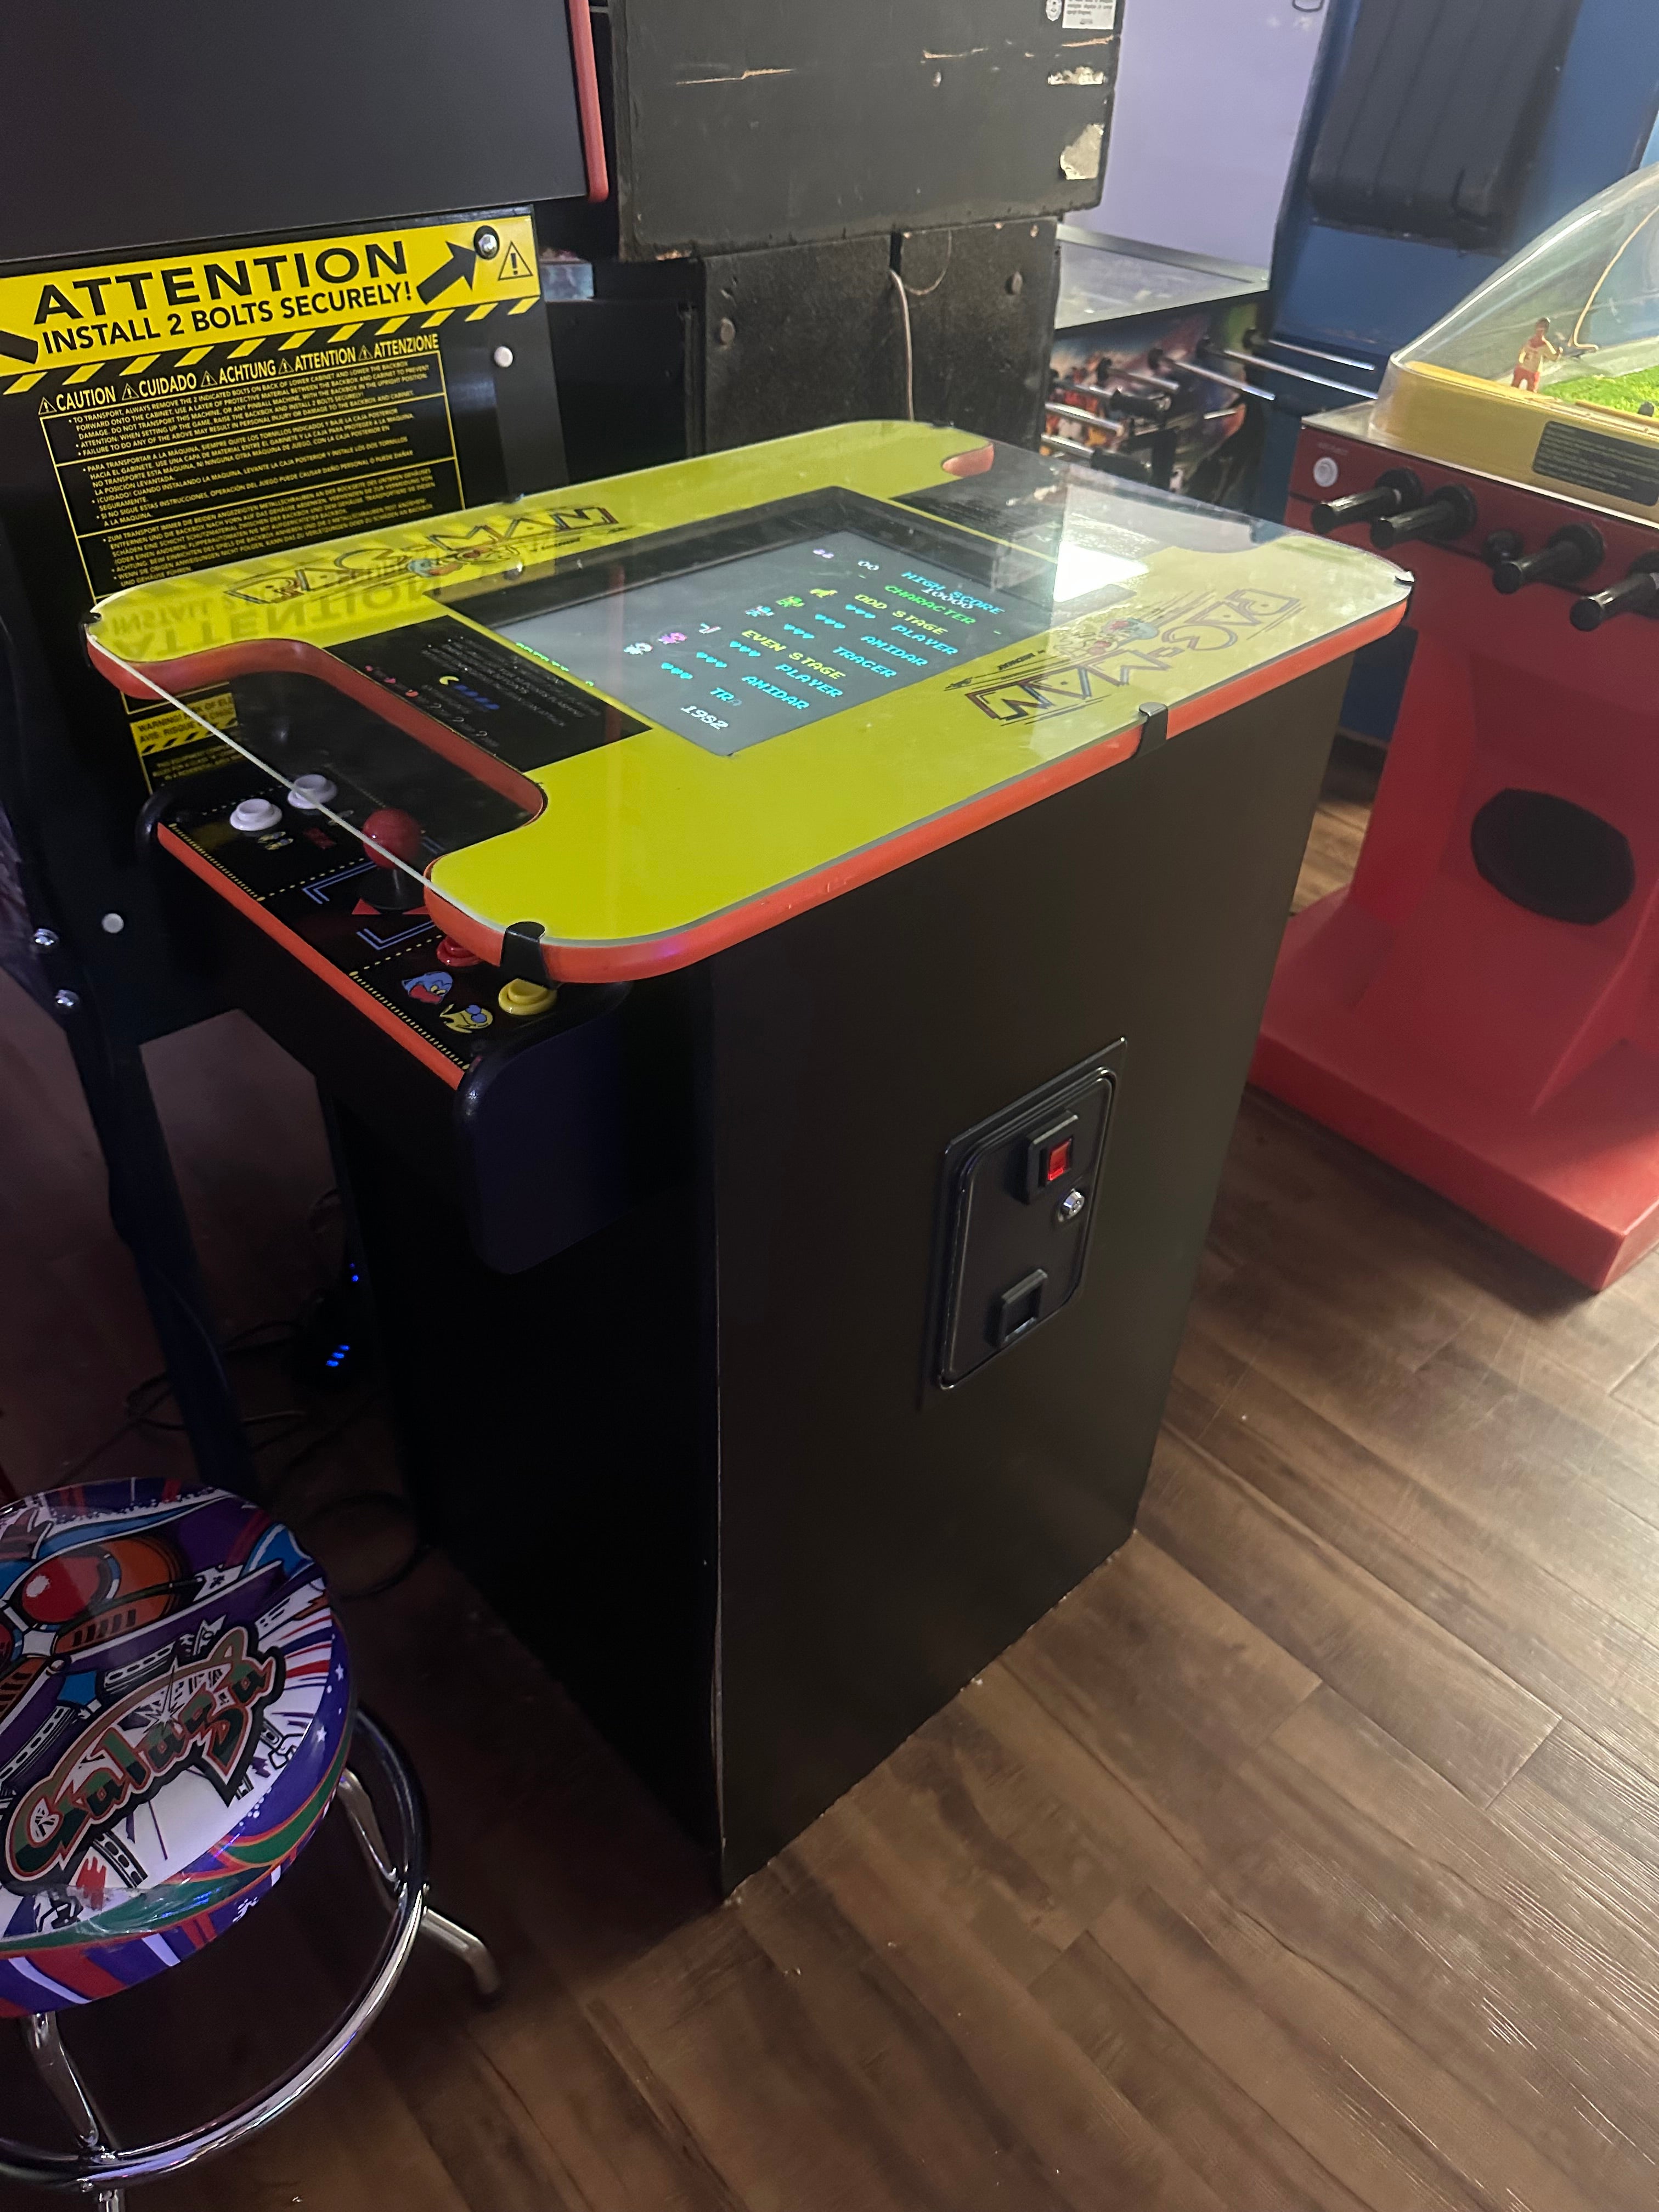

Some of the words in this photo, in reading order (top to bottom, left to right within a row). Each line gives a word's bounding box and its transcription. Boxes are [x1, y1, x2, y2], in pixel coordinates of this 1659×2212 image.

[34, 241, 408, 325] ATTENTION
[42, 319, 161, 355] INSTALL
[167, 313, 182, 336] 2
[194, 300, 273, 331] BOLTS
[282, 281, 412, 318] SECURELY!
[53, 385, 117, 412] CAUTION
[137, 372, 198, 398] CUIDADO
[216, 359, 277, 385] ACHTUNG
[292, 346, 357, 372] ATTENTION
[372, 332, 439, 359] ATTENZIONE
[125, 405, 151, 414] ALWAYS
[151, 400, 179, 409] REMOVE
[138, 417, 175, 428] TRANSPORT
[75, 420, 110, 431] FORWARD
[110, 416, 131, 425] ONTO
[119, 432, 141, 440] WHEN
[141, 427, 168, 436] SETTING
[82, 446, 109, 455] FAILURE
[171, 431, 193, 439] ABOVE
[884, 585, 976, 624] CHARACTER
[901, 571, 946, 591] HIGH
[950, 590, 1005, 614] SCORE
[922, 588, 973, 610] 10000
[855, 594, 887, 610] ODD
[893, 611, 948, 635] STAGE
[742, 630, 787, 652] EVEN
[789, 652, 845, 679] STAGE
[861, 636, 928, 666] AMIDAR
[891, 624, 958, 654] PLAYER
[833, 646, 896, 678] TRACER
[742, 676, 809, 709] AMIDAR
[775, 664, 843, 697] PLAYER
[681, 706, 729, 730] 1982
